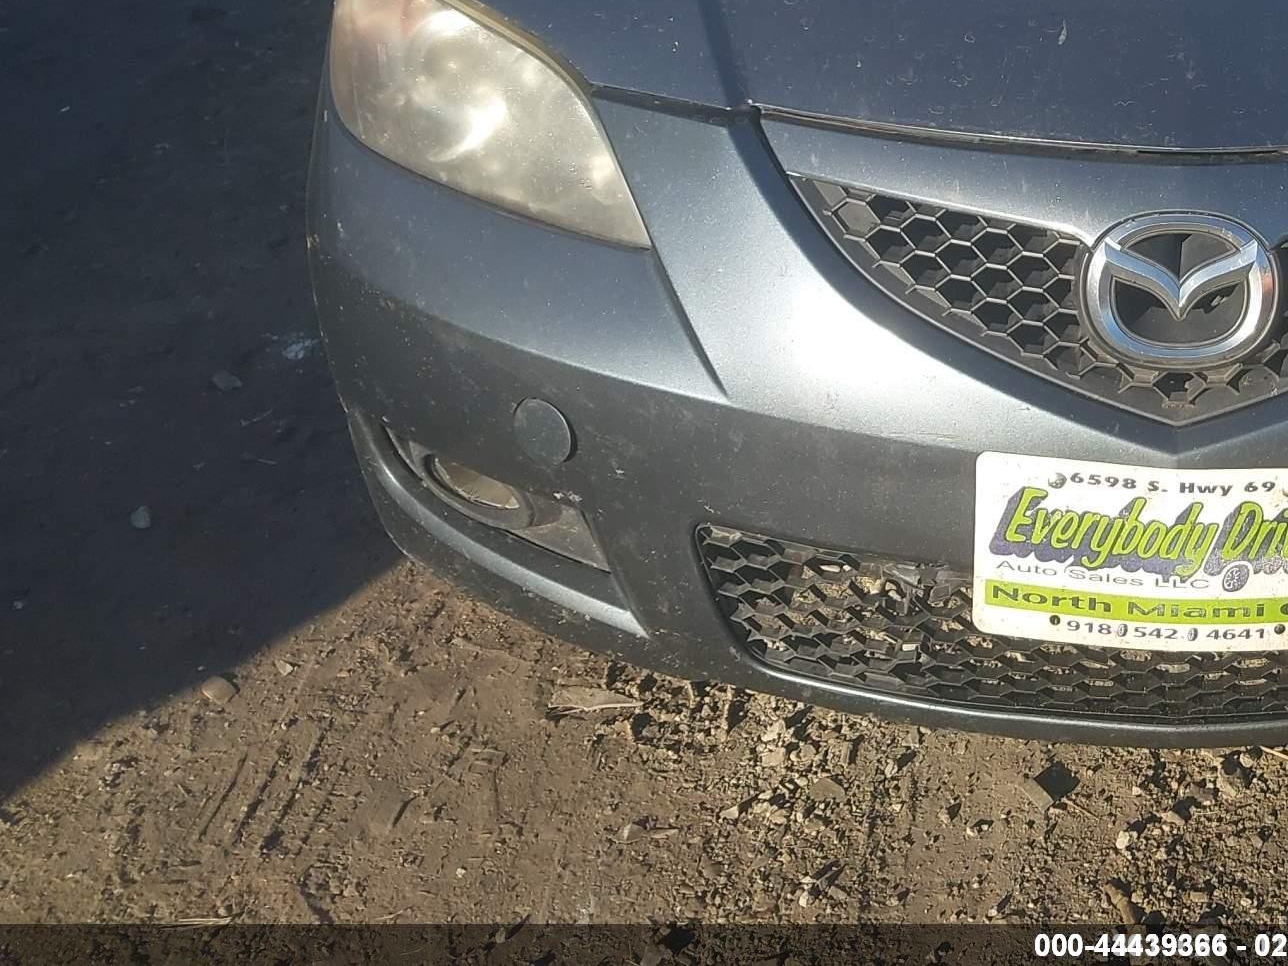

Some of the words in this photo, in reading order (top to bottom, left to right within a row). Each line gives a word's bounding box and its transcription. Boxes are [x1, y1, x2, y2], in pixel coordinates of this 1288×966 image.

[1069, 472, 1138, 490] 6598
[1146, 480, 1169, 493] S.
[1179, 481, 1234, 497] Hwy
[1244, 480, 1276, 493] 69
[1000, 486, 1220, 579] Everybody
[996, 560, 1058, 577] Auto
[1067, 566, 1144, 587] Sales
[1155, 576, 1210, 589] LLC
[992, 585, 1112, 613] North
[1127, 600, 1265, 618] Miami
[1066, 619, 1112, 636] 918
[1133, 625, 1179, 641] 542
[1205, 627, 1265, 641] 4641
